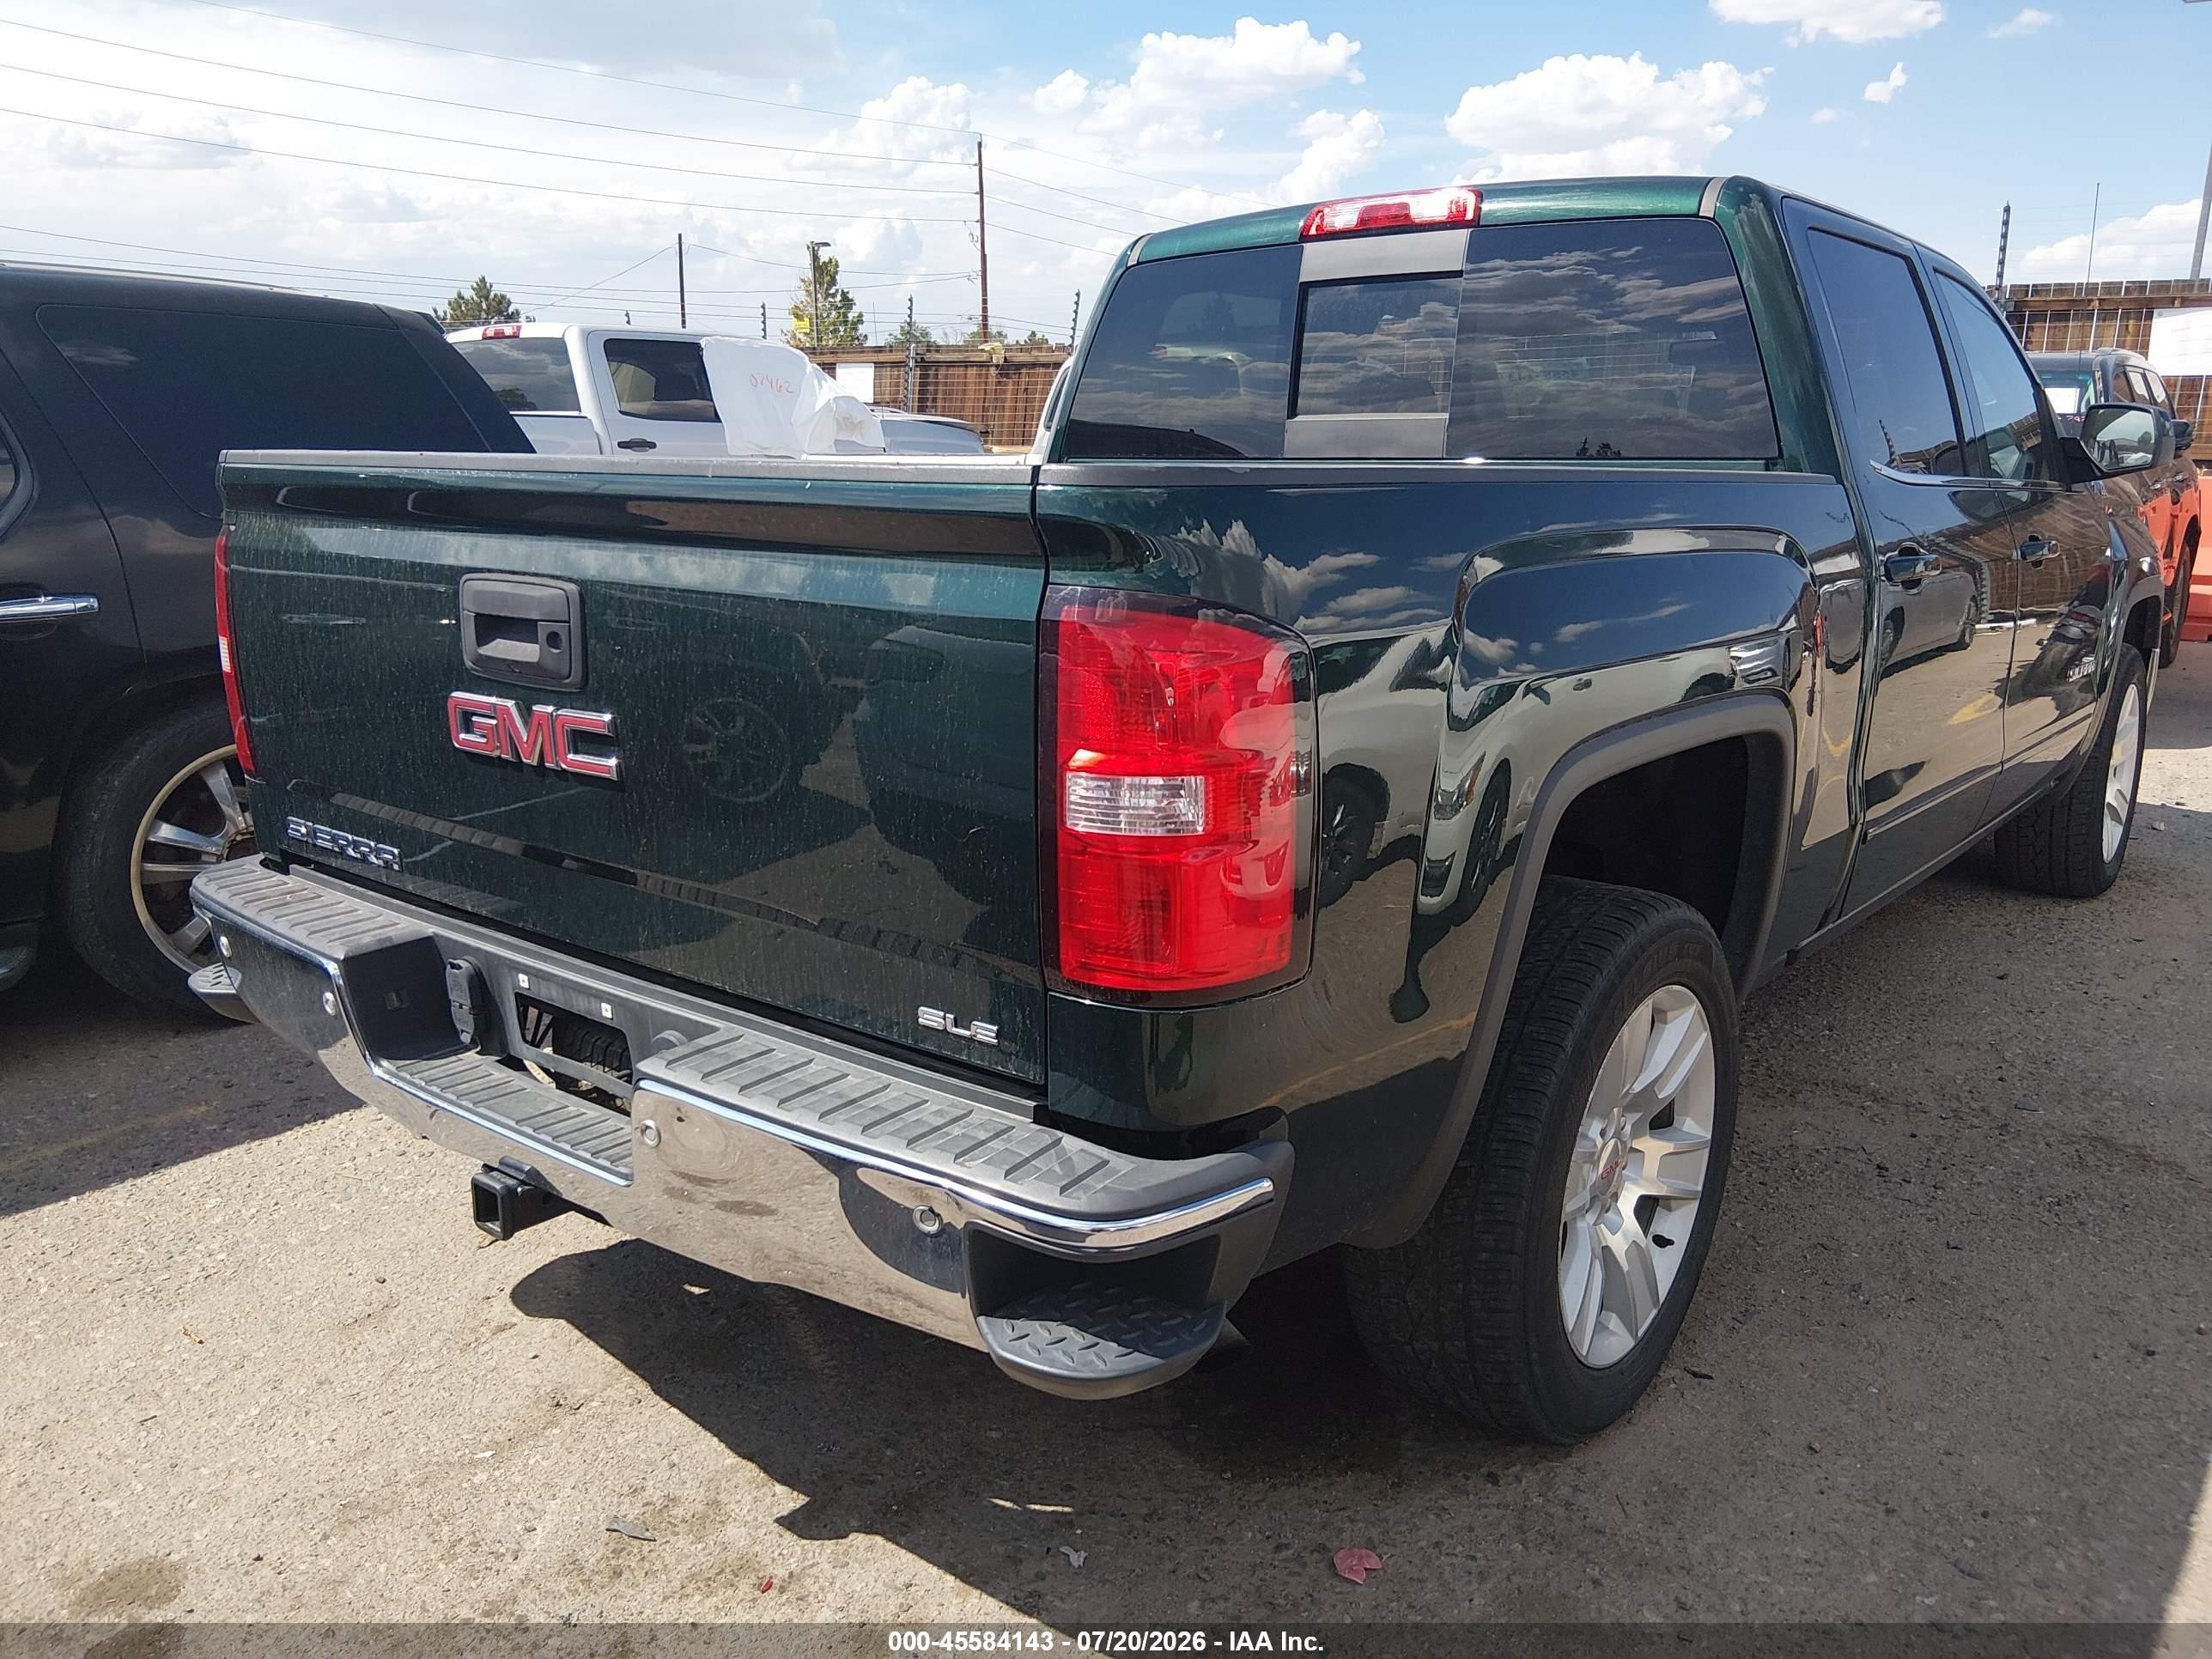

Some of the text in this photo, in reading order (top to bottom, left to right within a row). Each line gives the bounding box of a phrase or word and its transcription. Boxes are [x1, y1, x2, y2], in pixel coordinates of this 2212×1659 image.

[447, 690, 619, 781] GMC
[286, 816, 402, 872] SIERRA
[918, 1006, 999, 1045] SLE
